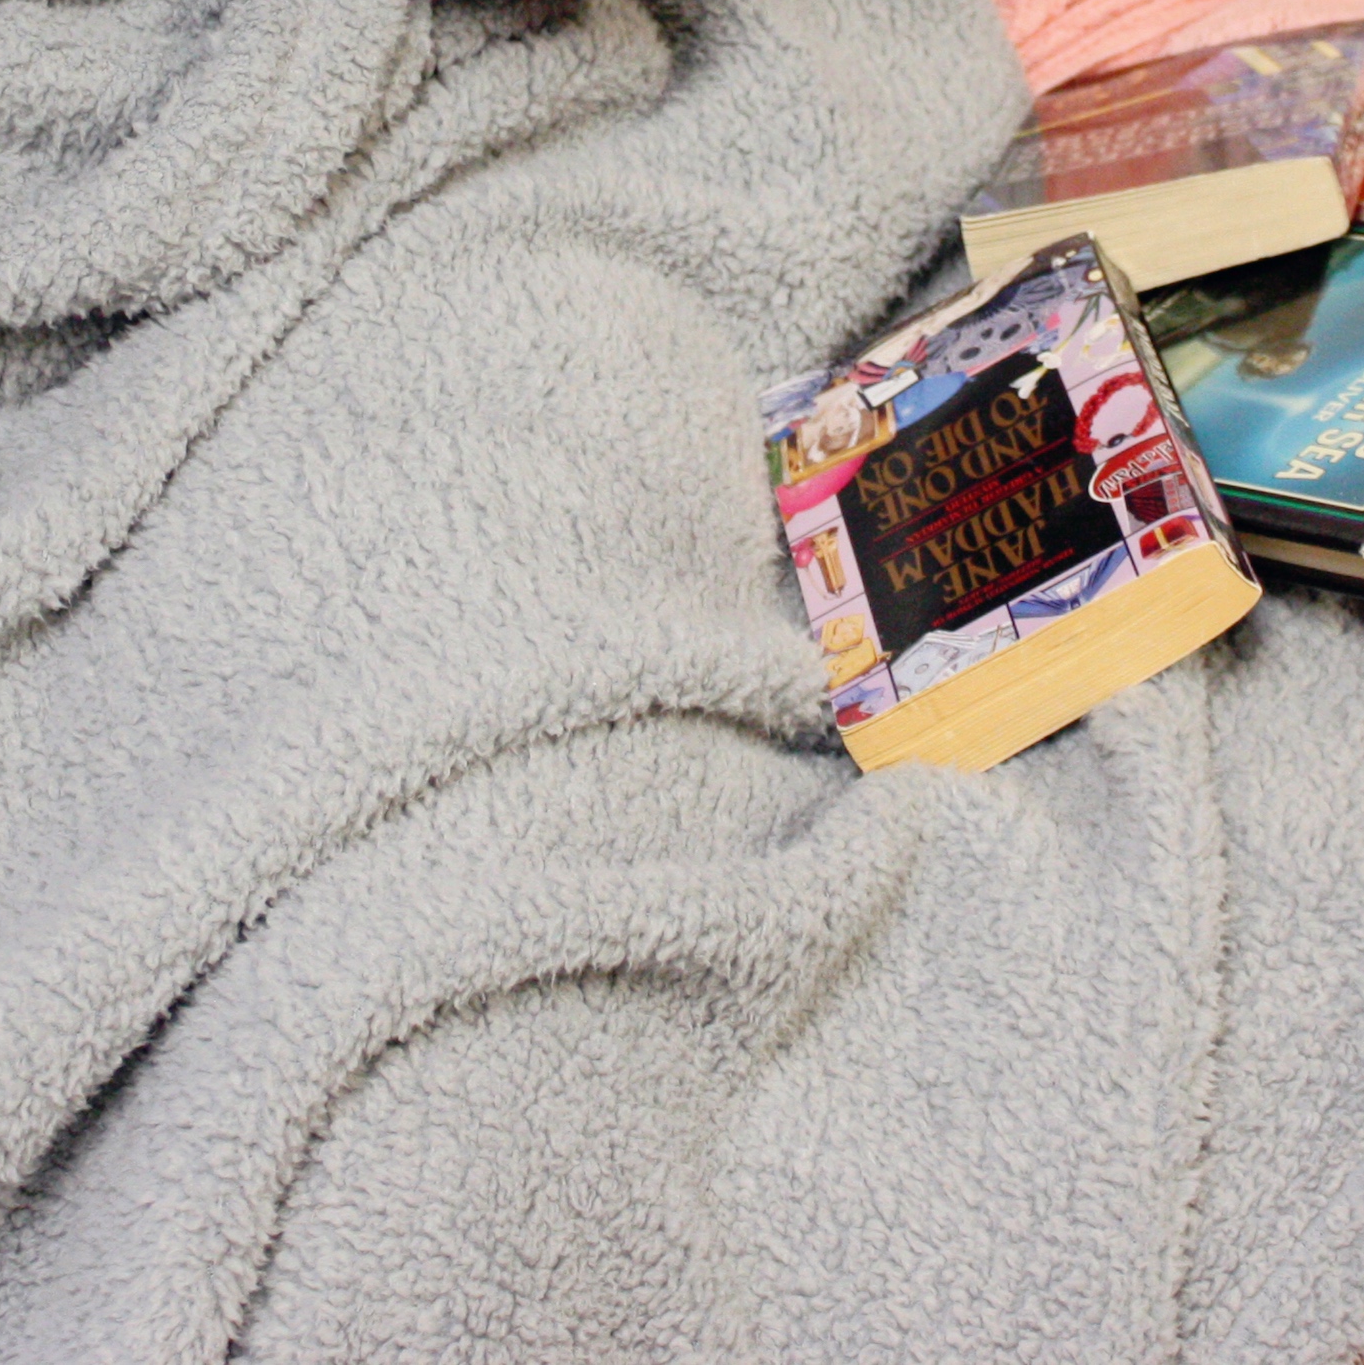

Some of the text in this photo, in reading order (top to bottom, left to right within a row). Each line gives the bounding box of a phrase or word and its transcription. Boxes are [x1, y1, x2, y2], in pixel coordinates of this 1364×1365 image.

[855, 391, 1049, 504] TO DIE ON
[867, 410, 1046, 532] AND ONE
[884, 464, 1084, 593] HADDAM
[933, 517, 1047, 604] JANE
